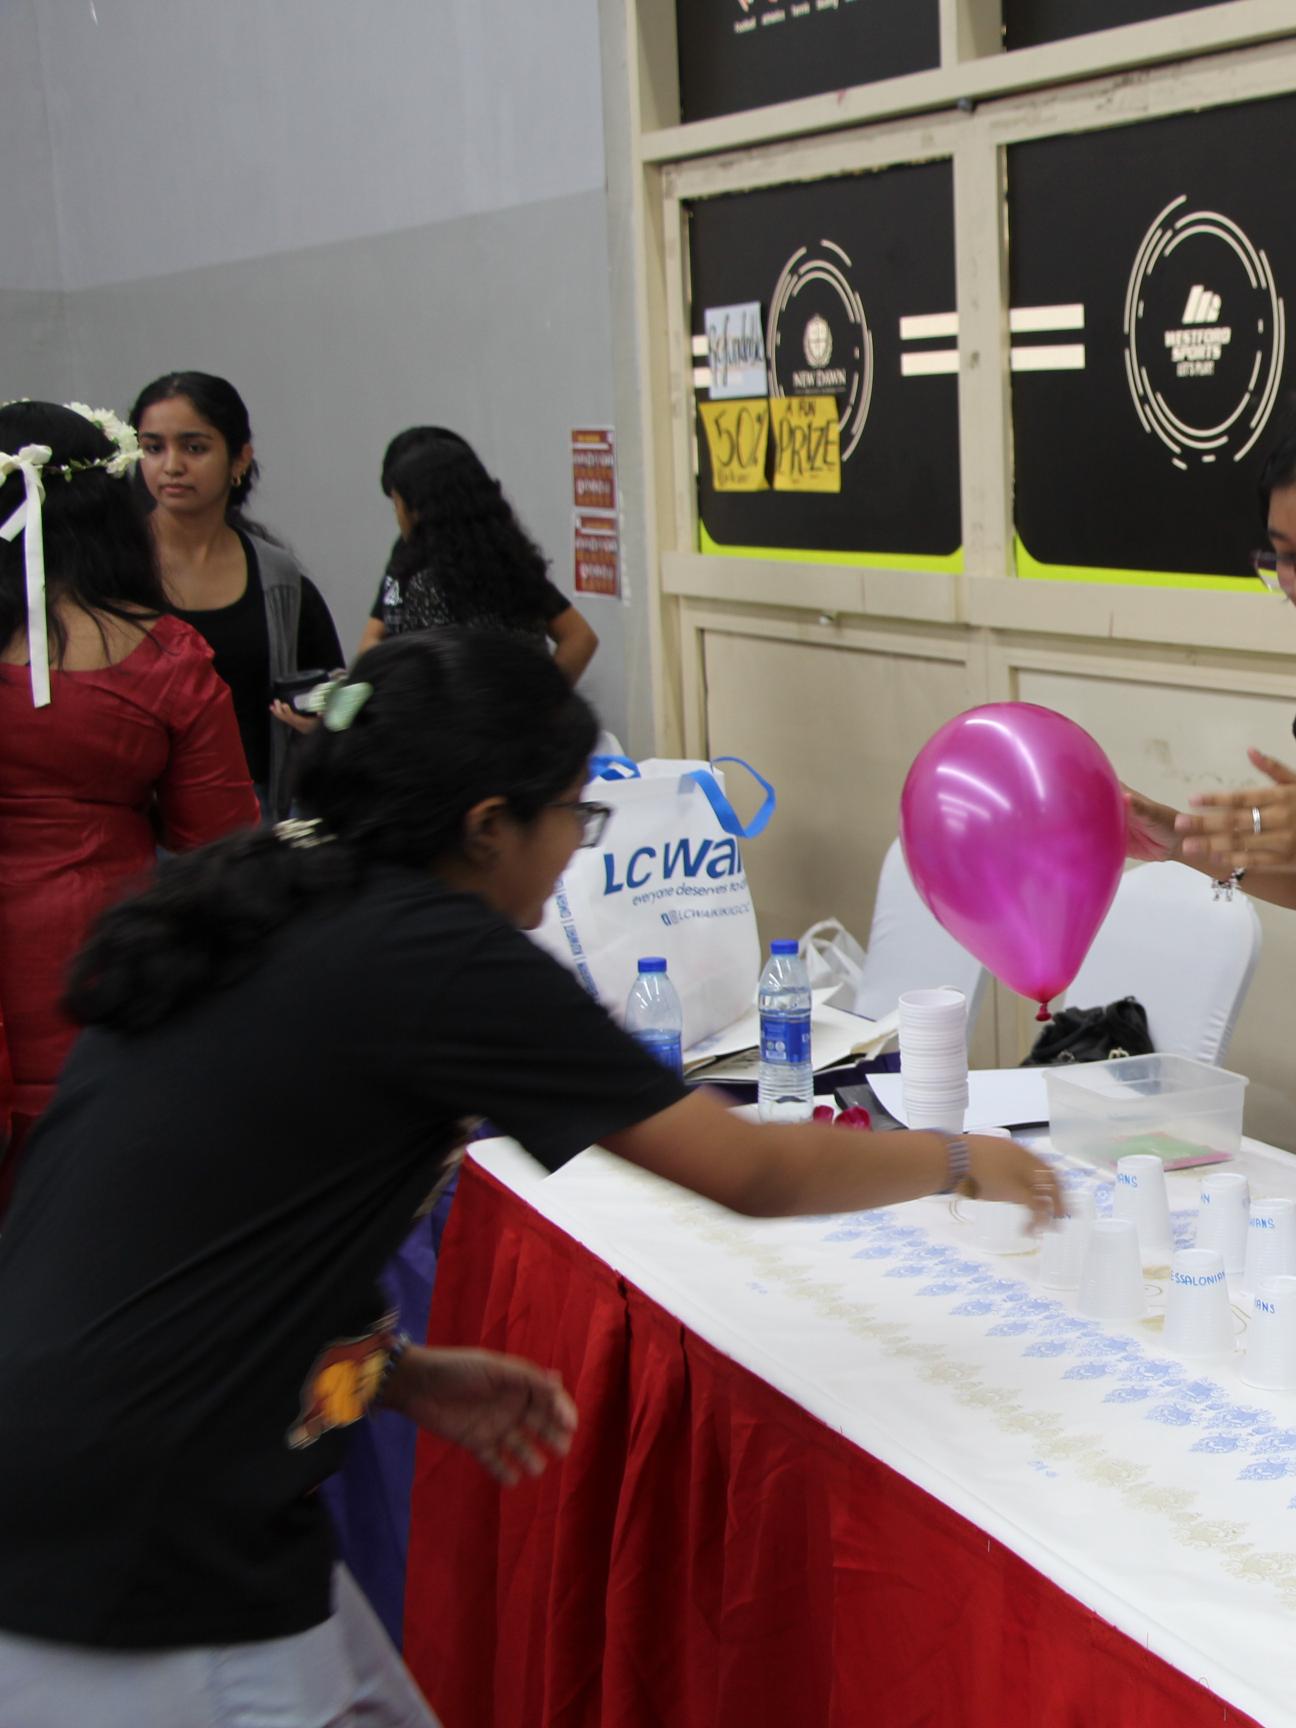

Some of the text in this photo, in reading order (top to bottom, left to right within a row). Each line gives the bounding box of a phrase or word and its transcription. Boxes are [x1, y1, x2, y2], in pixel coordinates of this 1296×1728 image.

[792, 368, 847, 388] NEW DAWN
[776, 417, 838, 475] PRIZE
[632, 886, 674, 906] everyone
[675, 882, 727, 896] deserves
